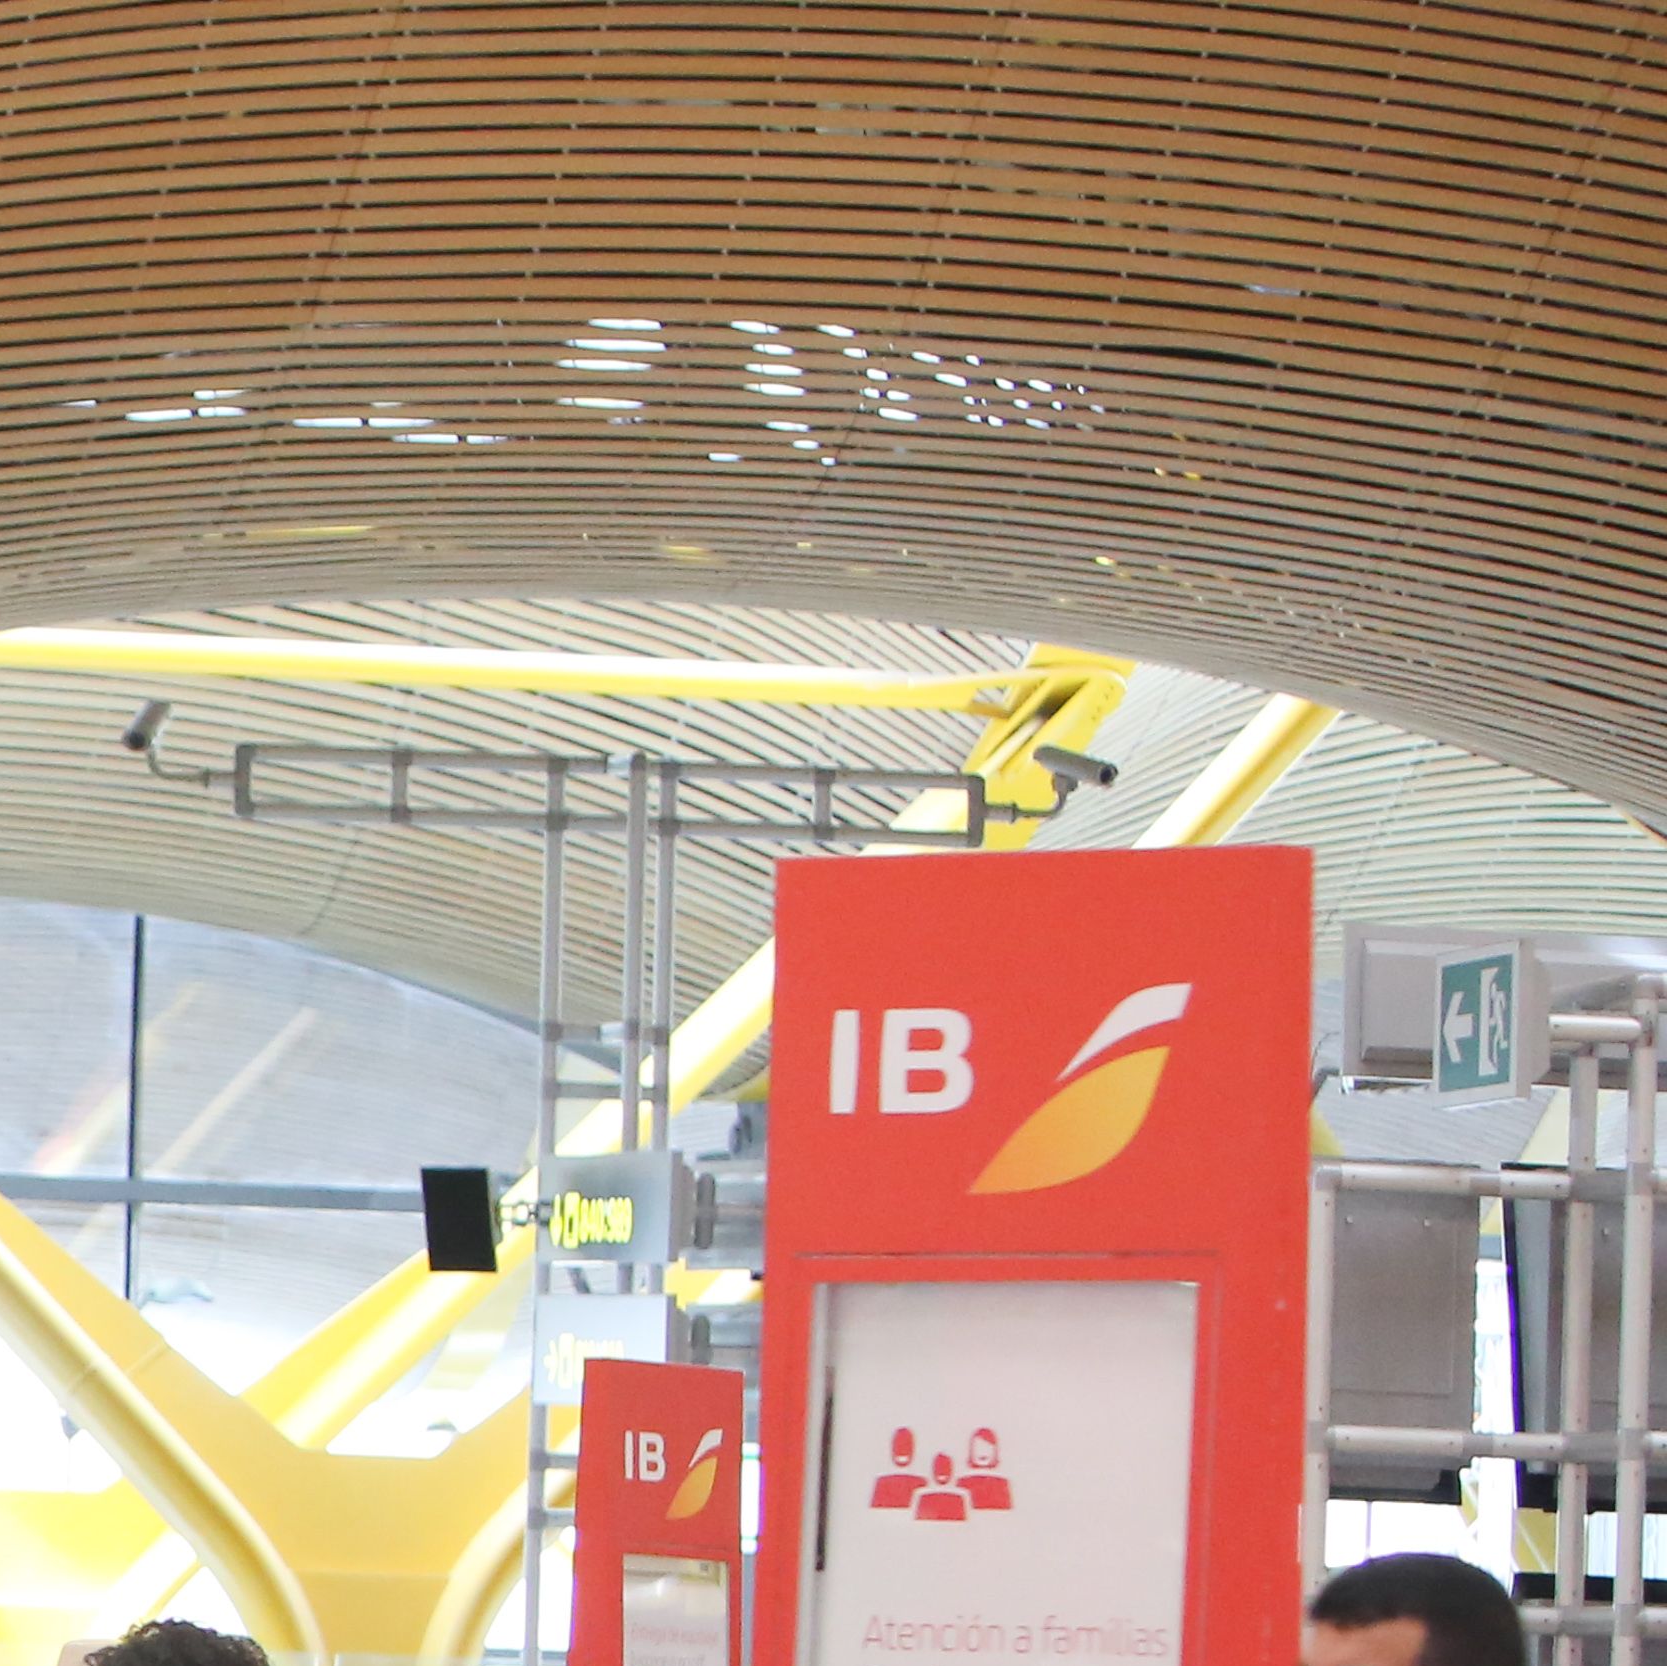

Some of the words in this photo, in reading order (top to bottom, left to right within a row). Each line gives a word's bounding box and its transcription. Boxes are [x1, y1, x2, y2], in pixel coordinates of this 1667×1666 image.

[829, 1008, 974, 1115] IB
[623, 1430, 666, 1482] IB
[861, 1612, 1004, 1654] Atención
[1014, 1625, 1034, 1654] a
[1041, 1613, 1170, 1658] familias
